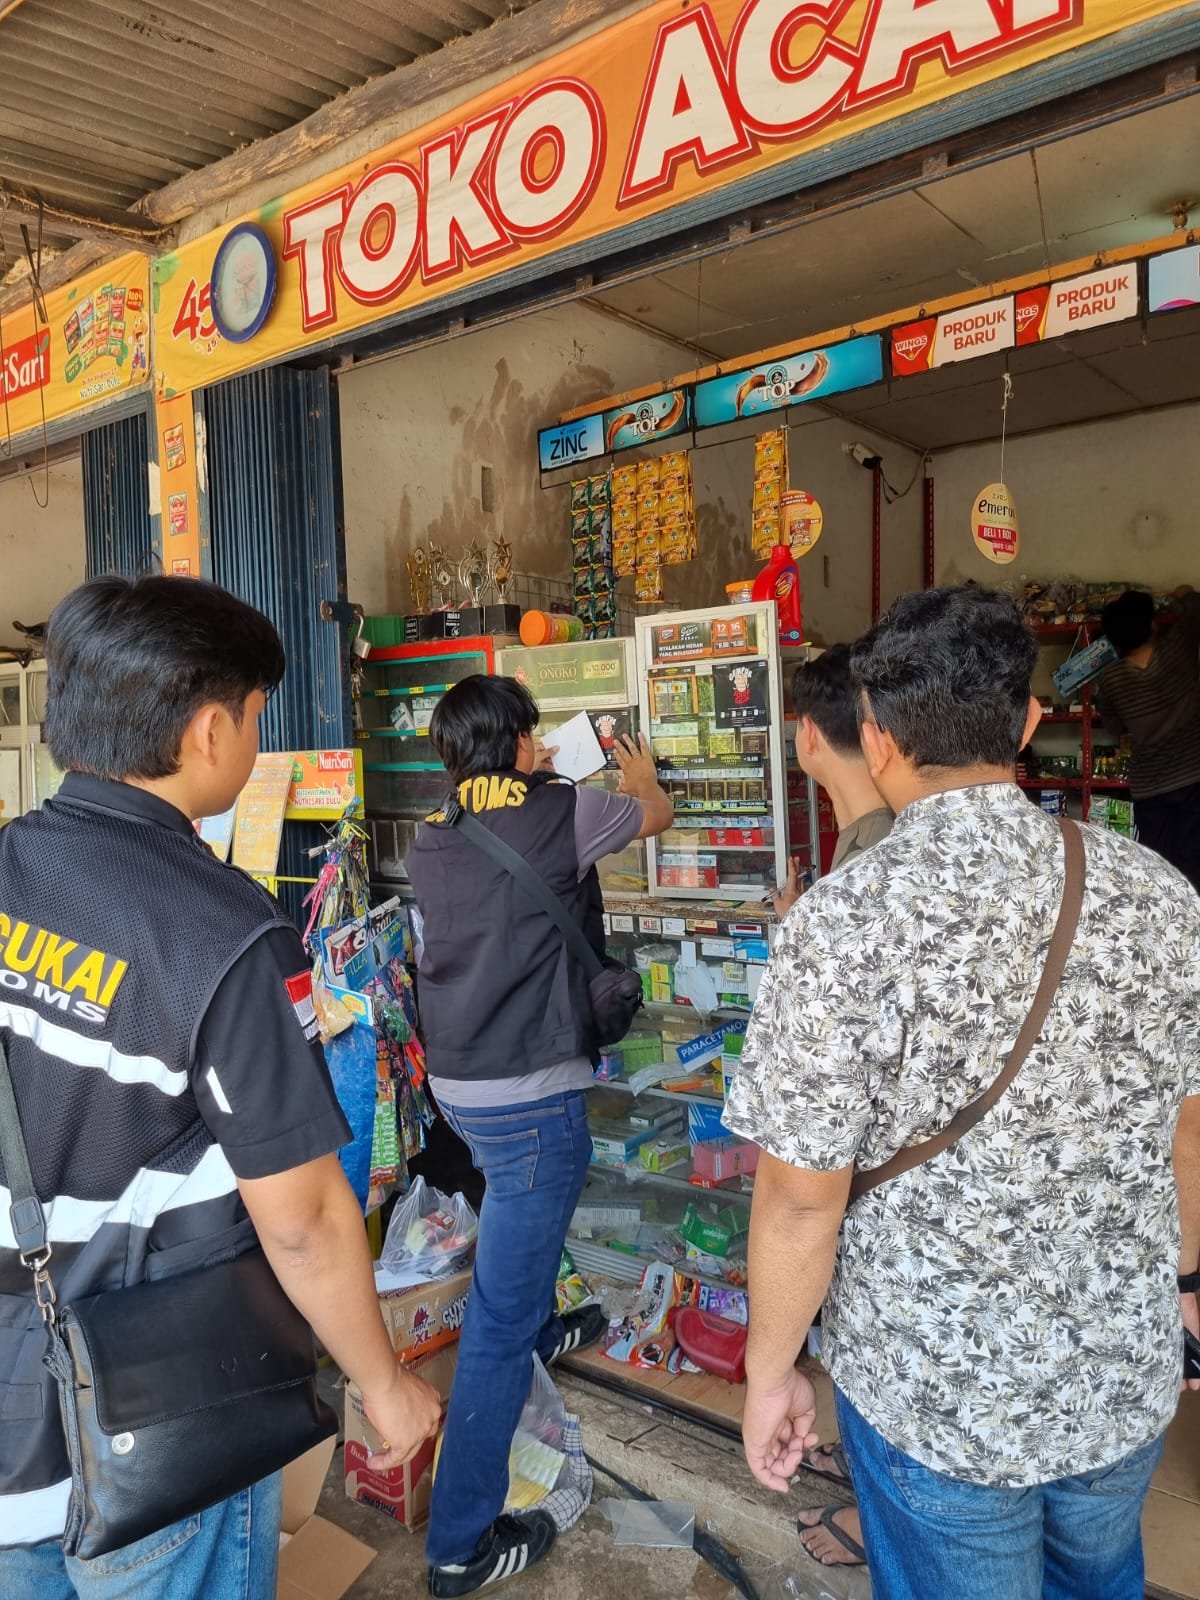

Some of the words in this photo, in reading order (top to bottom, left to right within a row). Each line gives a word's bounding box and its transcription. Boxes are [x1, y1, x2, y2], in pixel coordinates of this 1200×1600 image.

[284, 76, 606, 328] TOKO
[1056, 275, 1129, 308] PRODUK
[1068, 296, 1116, 321] BARU
[943, 309, 1007, 338] PRODUK
[895, 335, 928, 352] WINGS
[954, 327, 996, 351] BARU
[759, 379, 796, 402] TOP
[631, 416, 660, 436] TOP
[319, 752, 353, 769] NutriSari
